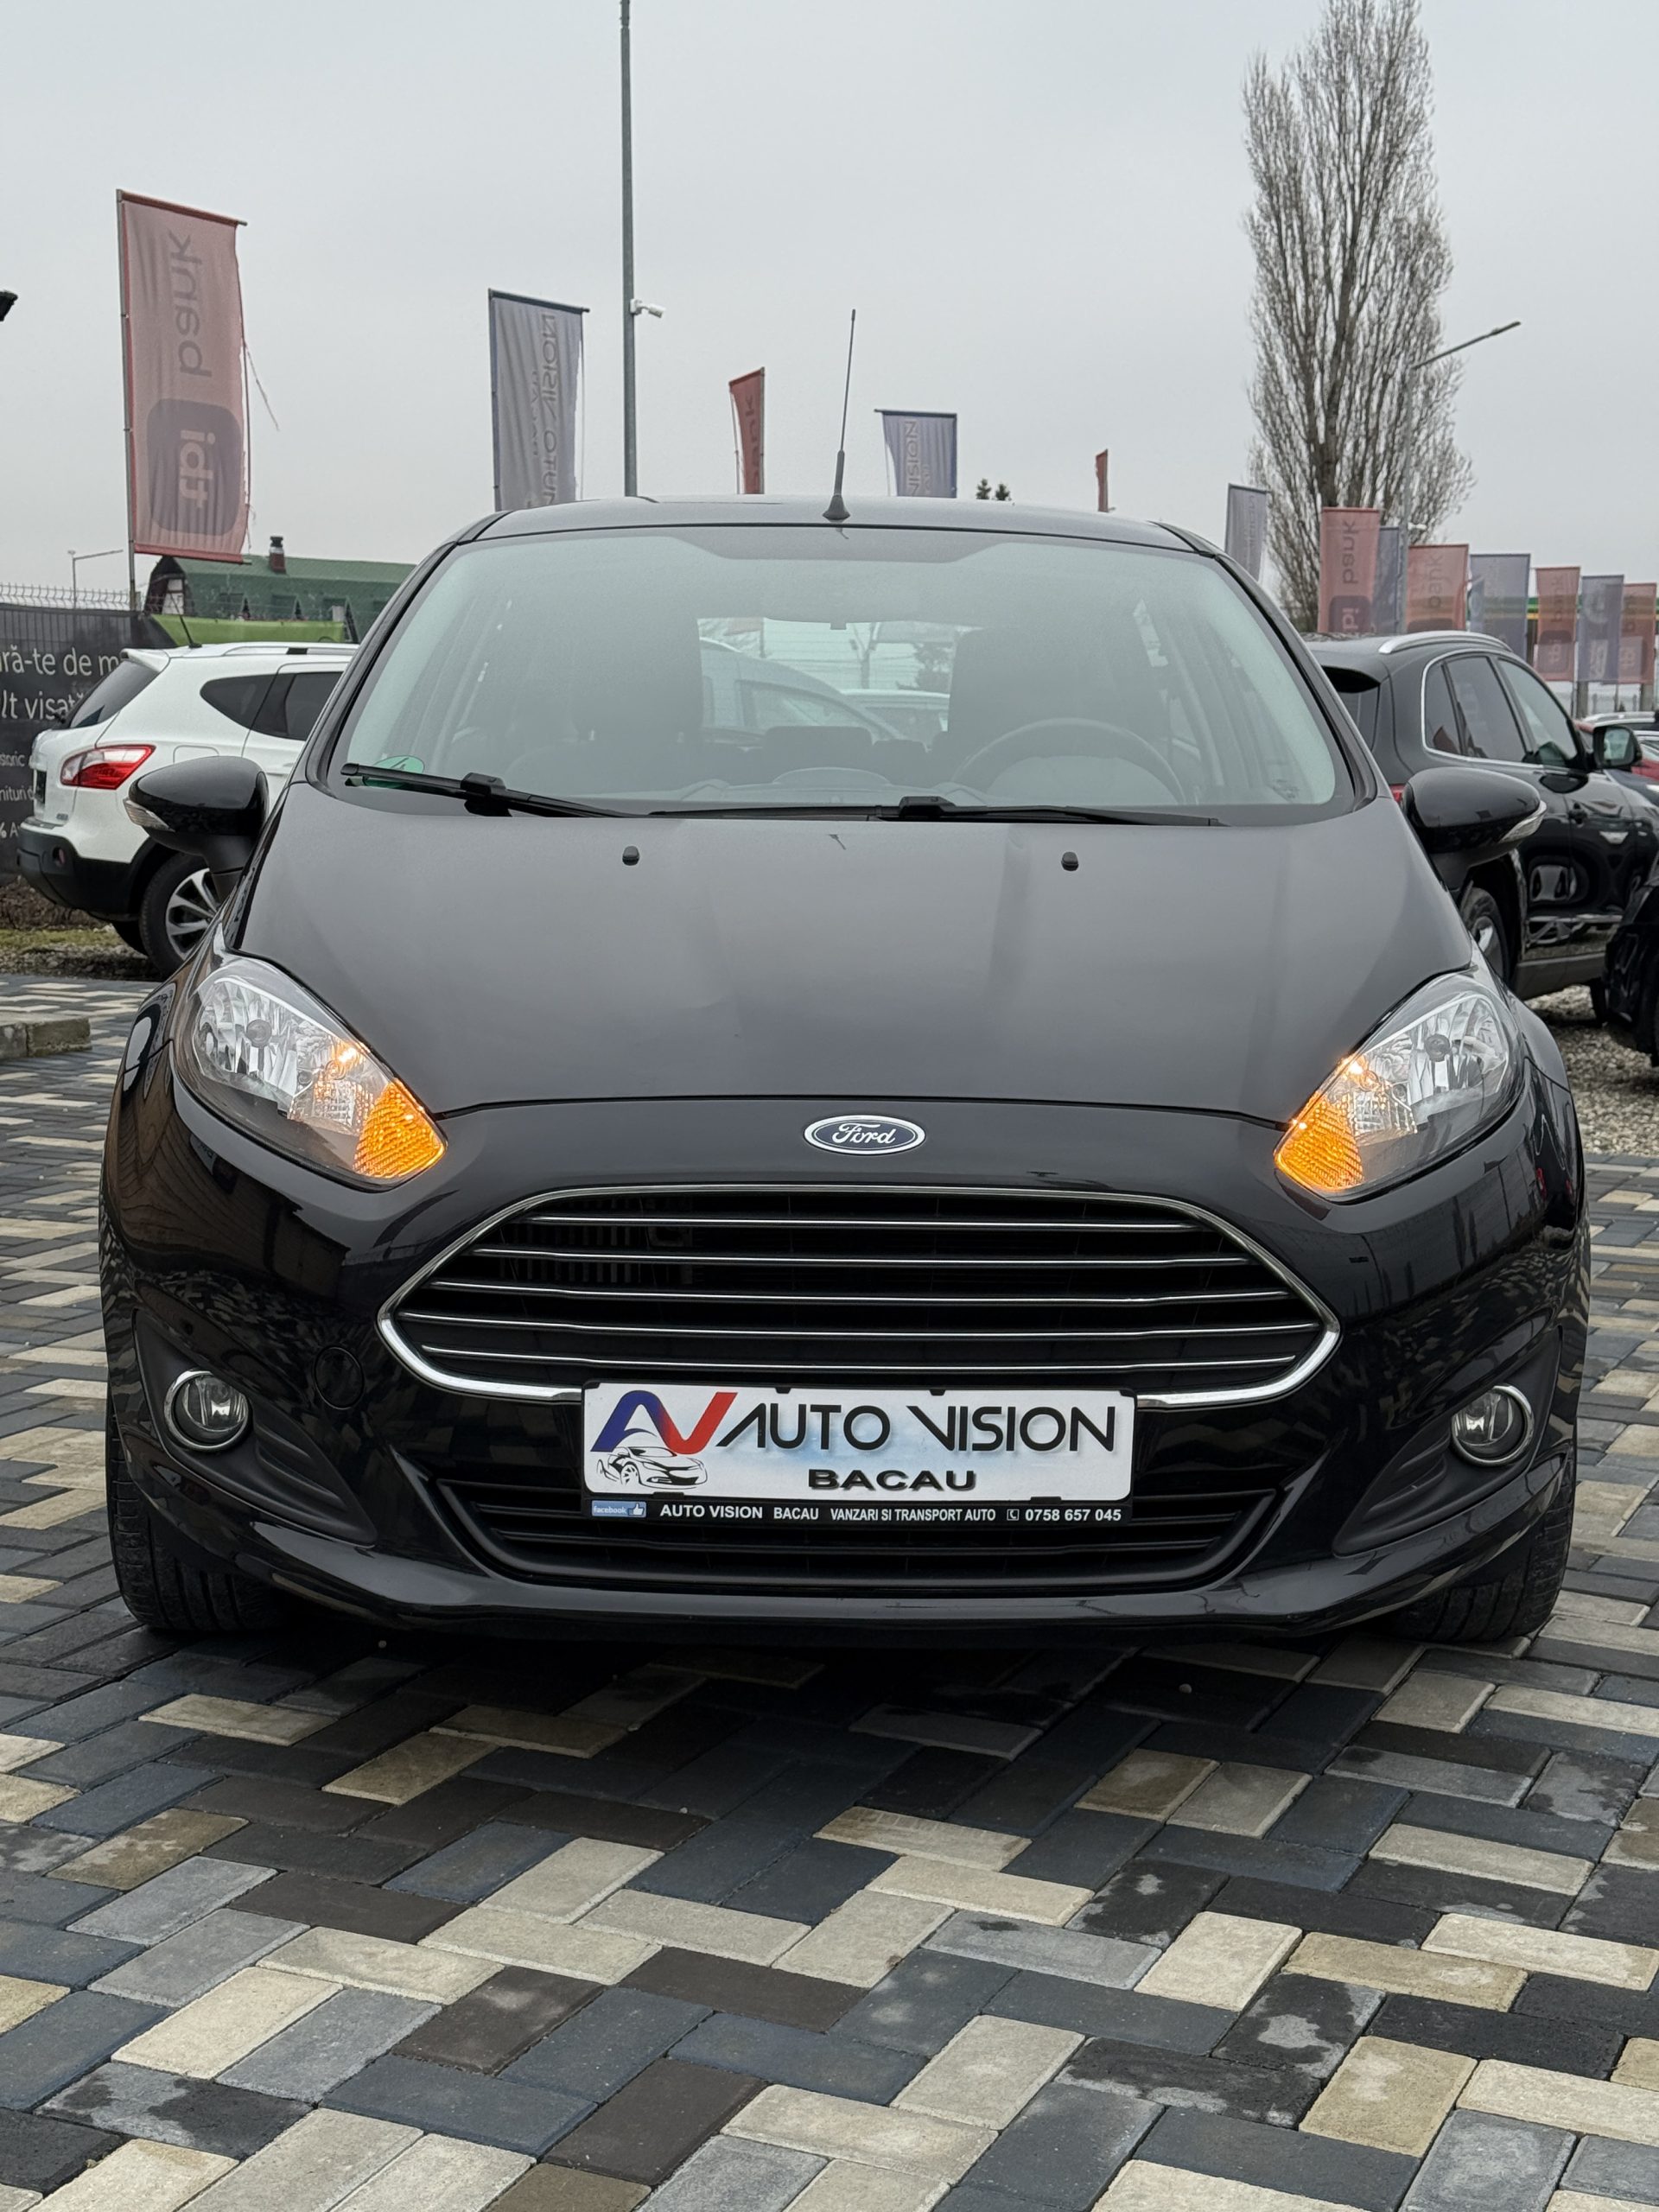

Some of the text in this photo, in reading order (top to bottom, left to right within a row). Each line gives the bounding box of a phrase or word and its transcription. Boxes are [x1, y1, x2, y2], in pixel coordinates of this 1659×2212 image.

[0, 644, 55, 675] ră-te
[63, 647, 92, 676] de
[831, 1122, 897, 1144] Ford
[715, 1402, 891, 1451] AUTO
[906, 1406, 1116, 1452] VISION
[808, 1469, 976, 1492] BACAU
[593, 1505, 627, 1515] facebook
[660, 1504, 1122, 1522] AUTO VISION BACAU VANZARI SI TRANSPORT AUTO 0758 657 045
